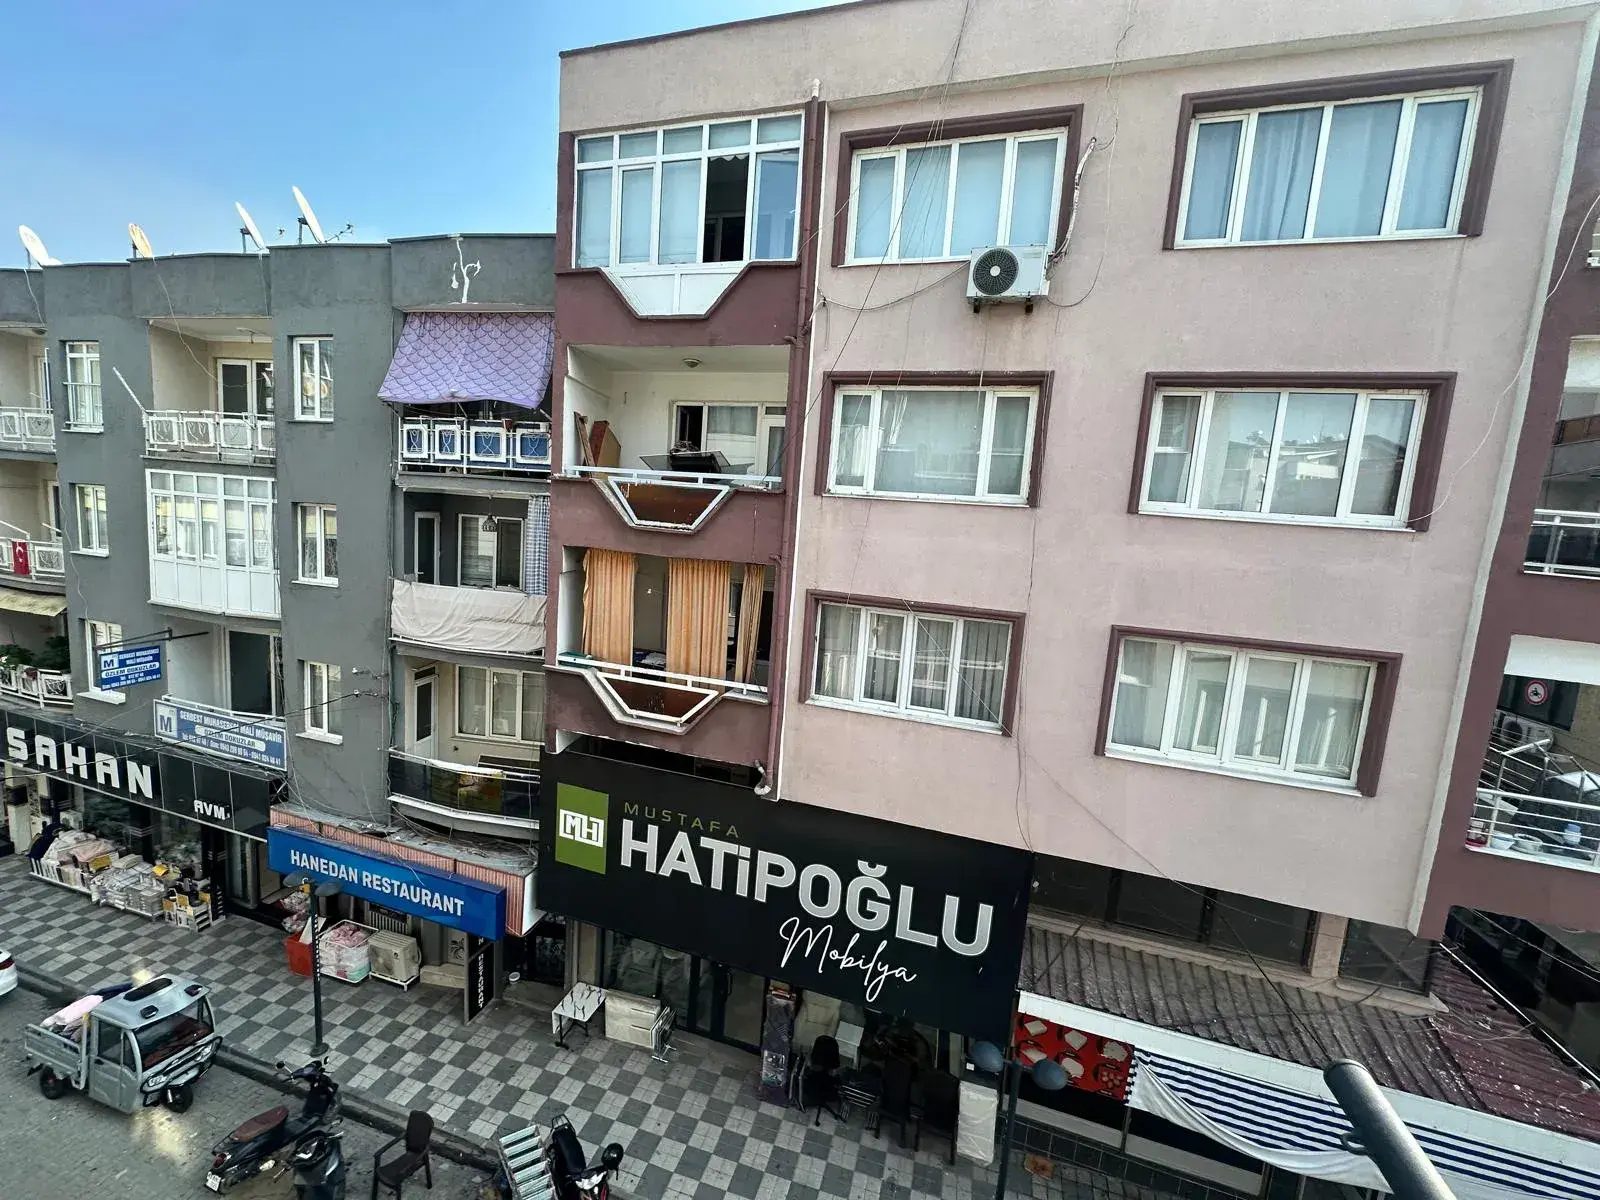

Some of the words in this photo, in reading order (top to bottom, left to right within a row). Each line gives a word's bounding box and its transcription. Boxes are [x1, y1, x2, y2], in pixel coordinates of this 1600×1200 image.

[103, 659, 115, 668] M
[160, 714, 172, 732] M
[180, 710, 203, 723] SERBEST
[240, 723, 255, 737] MALİ
[255, 729, 282, 744] MÜŞAVİR
[224, 734, 255, 748] DOKUZLAR
[624, 801, 739, 839] MUSTAFA
[291, 849, 358, 884] HANEDAN
[362, 871, 465, 917] RESTAURANT
[779, 916, 917, 1002] Mobilya
